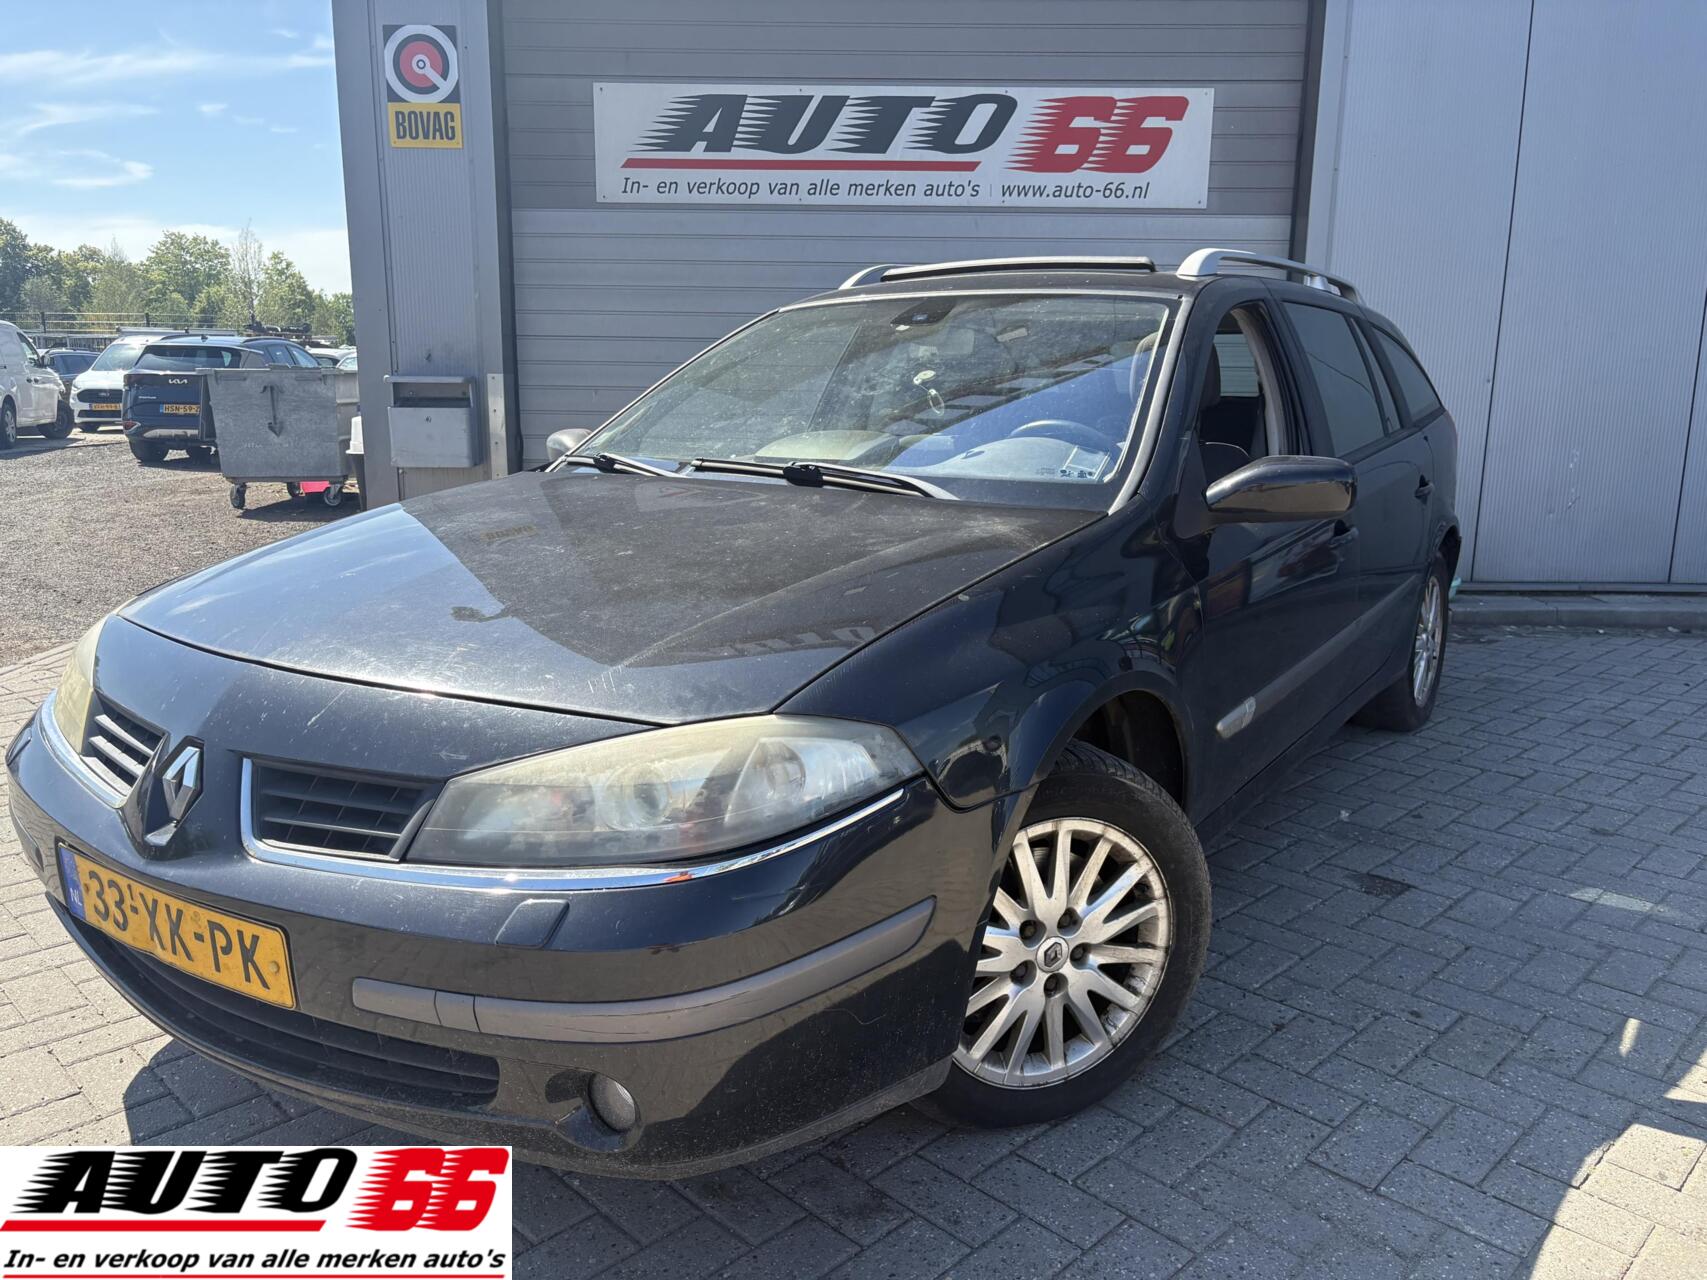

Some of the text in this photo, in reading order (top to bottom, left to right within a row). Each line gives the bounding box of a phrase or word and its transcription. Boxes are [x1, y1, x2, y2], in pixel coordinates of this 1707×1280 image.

[394, 110, 456, 141] BOVAG
[628, 93, 1189, 174] AUTO 66
[621, 177, 1150, 200] In- en verkoop van alle merken auto's www.auto-66.nl
